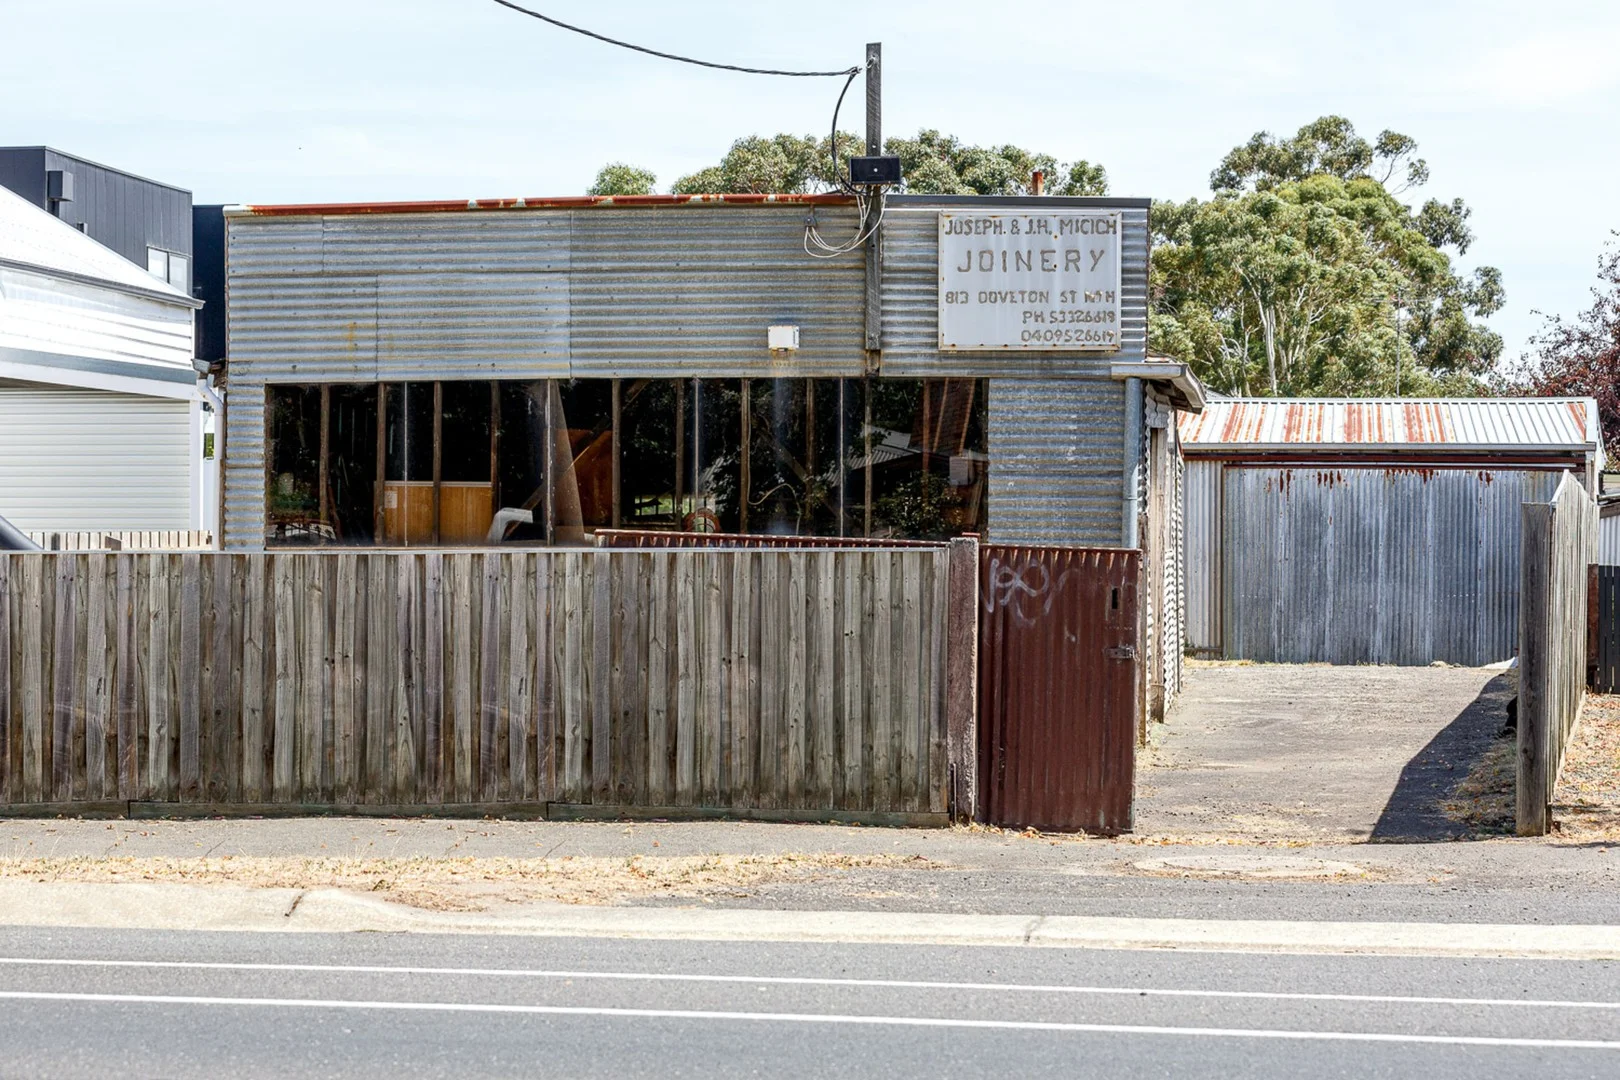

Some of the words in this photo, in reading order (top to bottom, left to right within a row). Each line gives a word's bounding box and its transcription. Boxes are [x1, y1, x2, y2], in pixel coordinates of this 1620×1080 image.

[945, 219, 1007, 236] JOSEPH.
[1010, 219, 1021, 236] &
[1059, 218, 1117, 236] MICICH
[957, 249, 1105, 273] JOINERY
[945, 290, 969, 304] 813
[978, 290, 1050, 304] DOVETON
[1060, 290, 1077, 304] ST
[1022, 310, 1045, 325] PH
[1021, 329, 1115, 343] 0409526619
